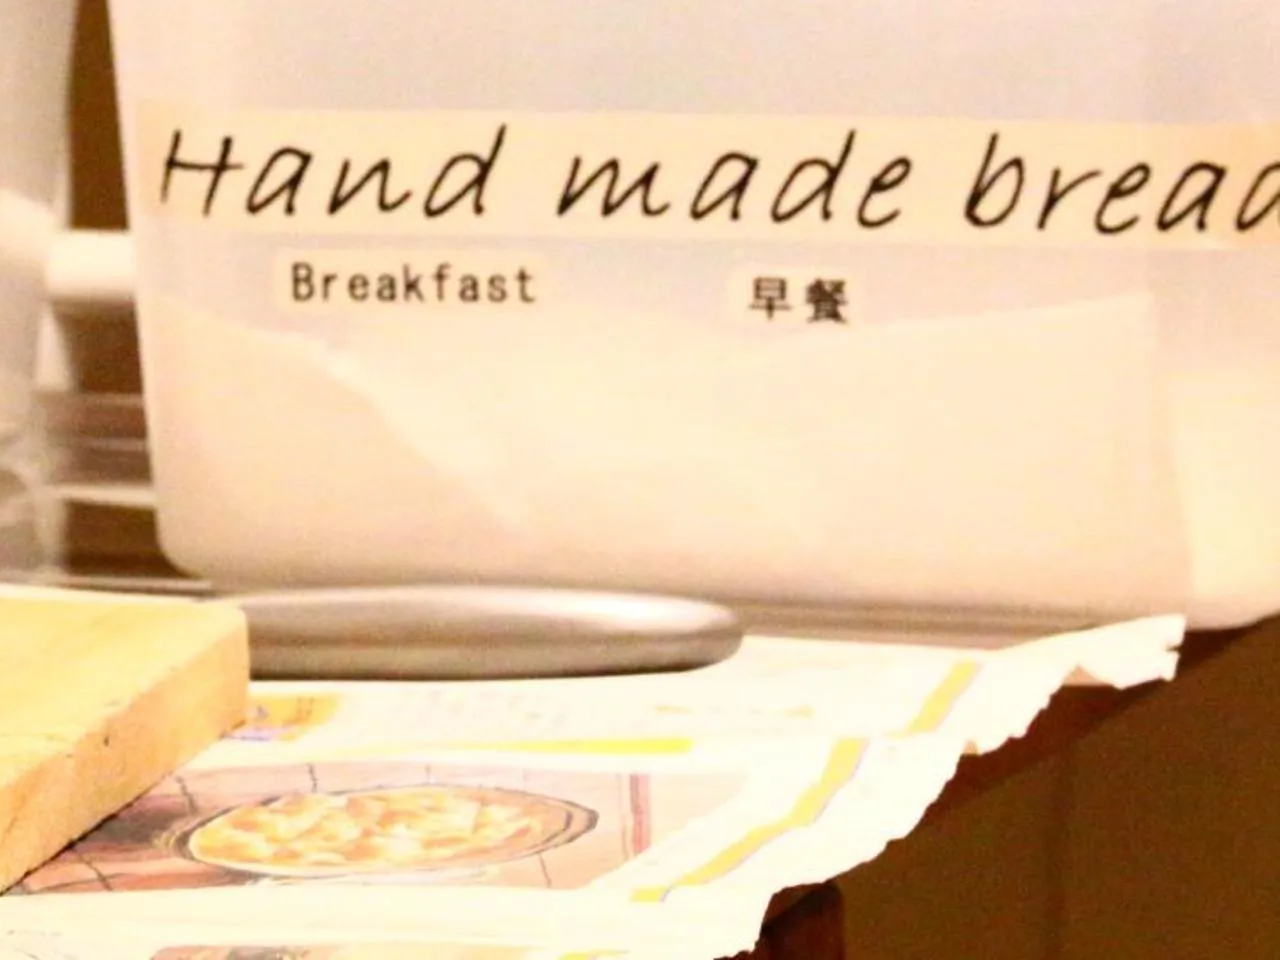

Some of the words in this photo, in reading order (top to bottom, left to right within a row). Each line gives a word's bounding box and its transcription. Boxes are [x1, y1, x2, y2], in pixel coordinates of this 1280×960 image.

[159, 123, 509, 221] Hand
[555, 129, 914, 231] made
[290, 261, 536, 305] Breakfast
[749, 276, 850, 326] 早餐
